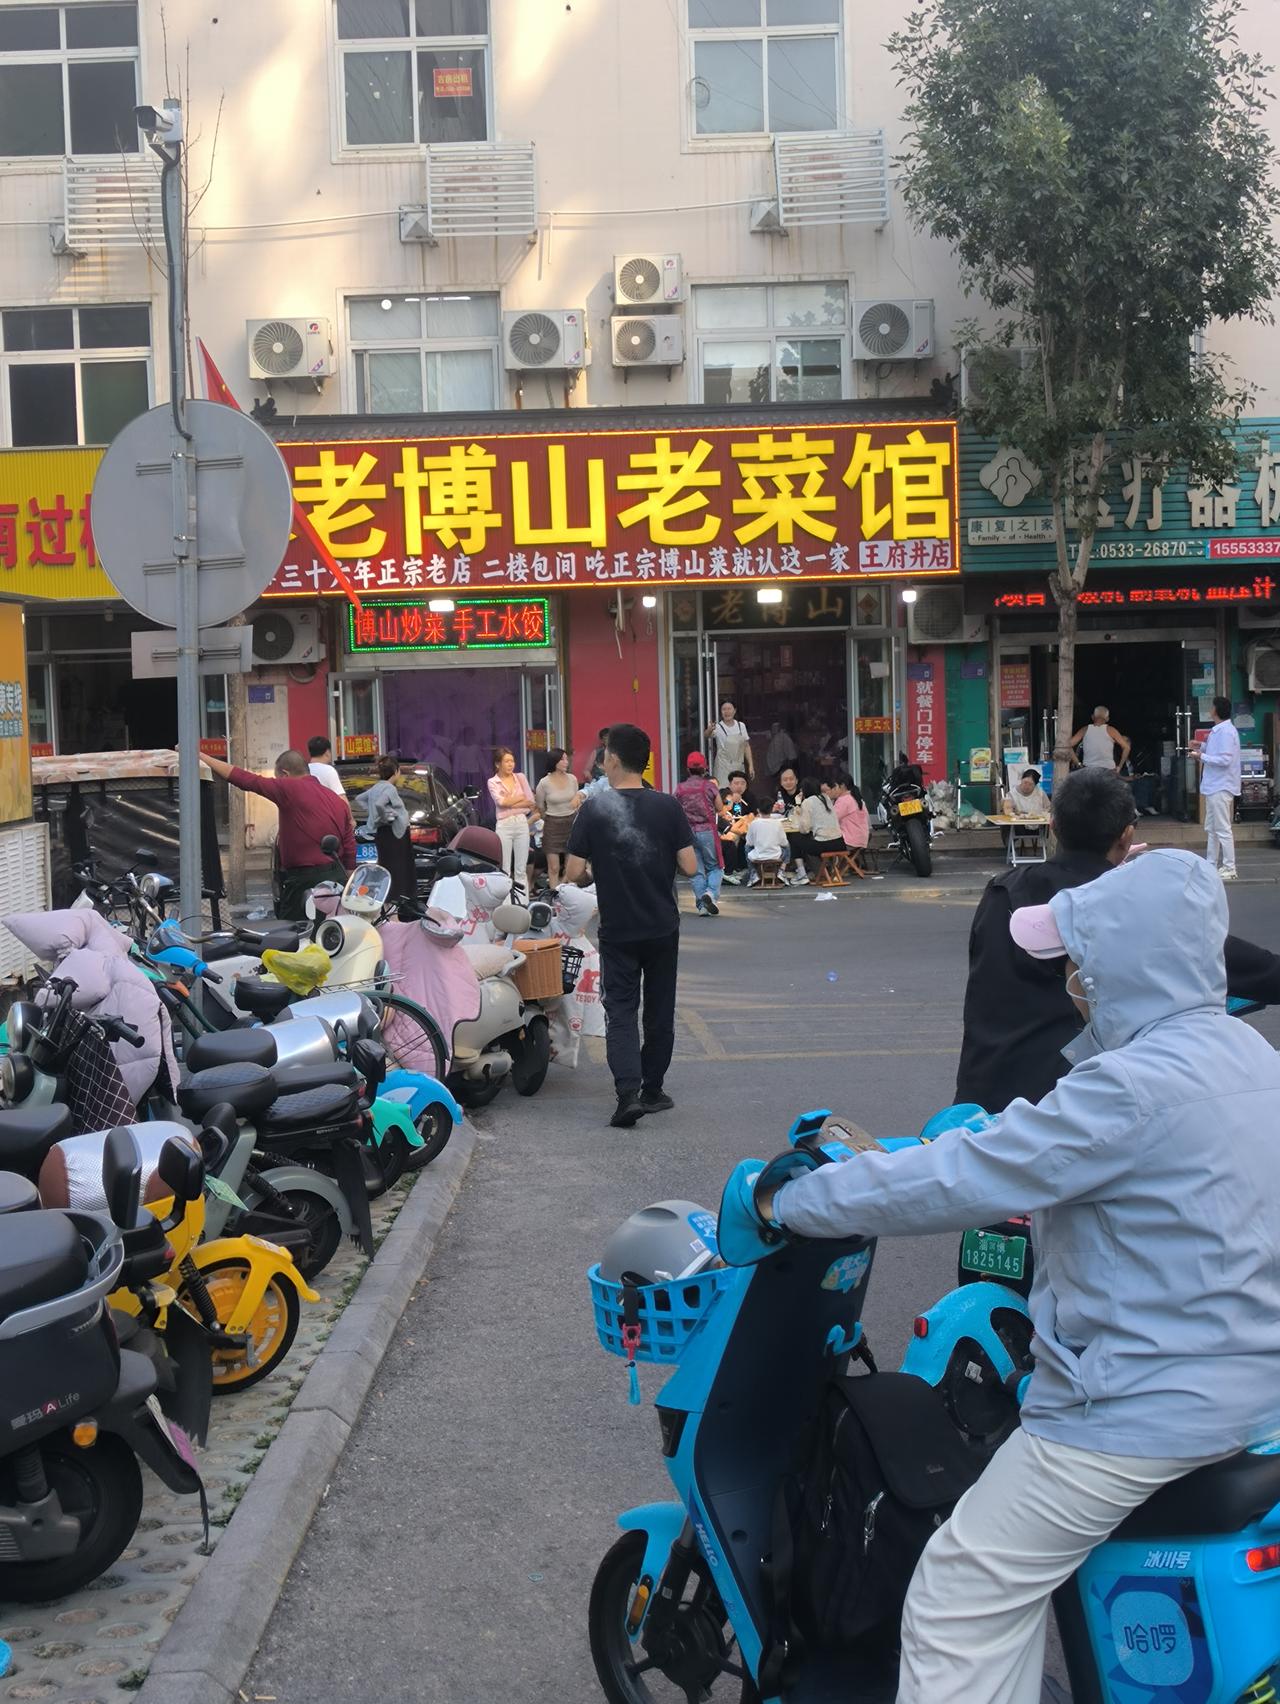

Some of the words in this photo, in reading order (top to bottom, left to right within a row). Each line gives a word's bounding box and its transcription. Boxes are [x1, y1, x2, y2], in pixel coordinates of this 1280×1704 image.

[482, 551, 576, 582] 二楼包间
[585, 543, 850, 579] 吃正宗博山菜就认这一家
[861, 543, 949, 569] 王府井店
[355, 608, 446, 644] 博山炒菜
[453, 605, 543, 642] 手工水饺
[915, 680, 934, 763] 就餐门口停车
[967, 1249, 1019, 1272] 1825145
[58, 1393, 80, 1409] Life
[1144, 1550, 1191, 1568] 冰川号
[1124, 1623, 1176, 1654] 哈啰
